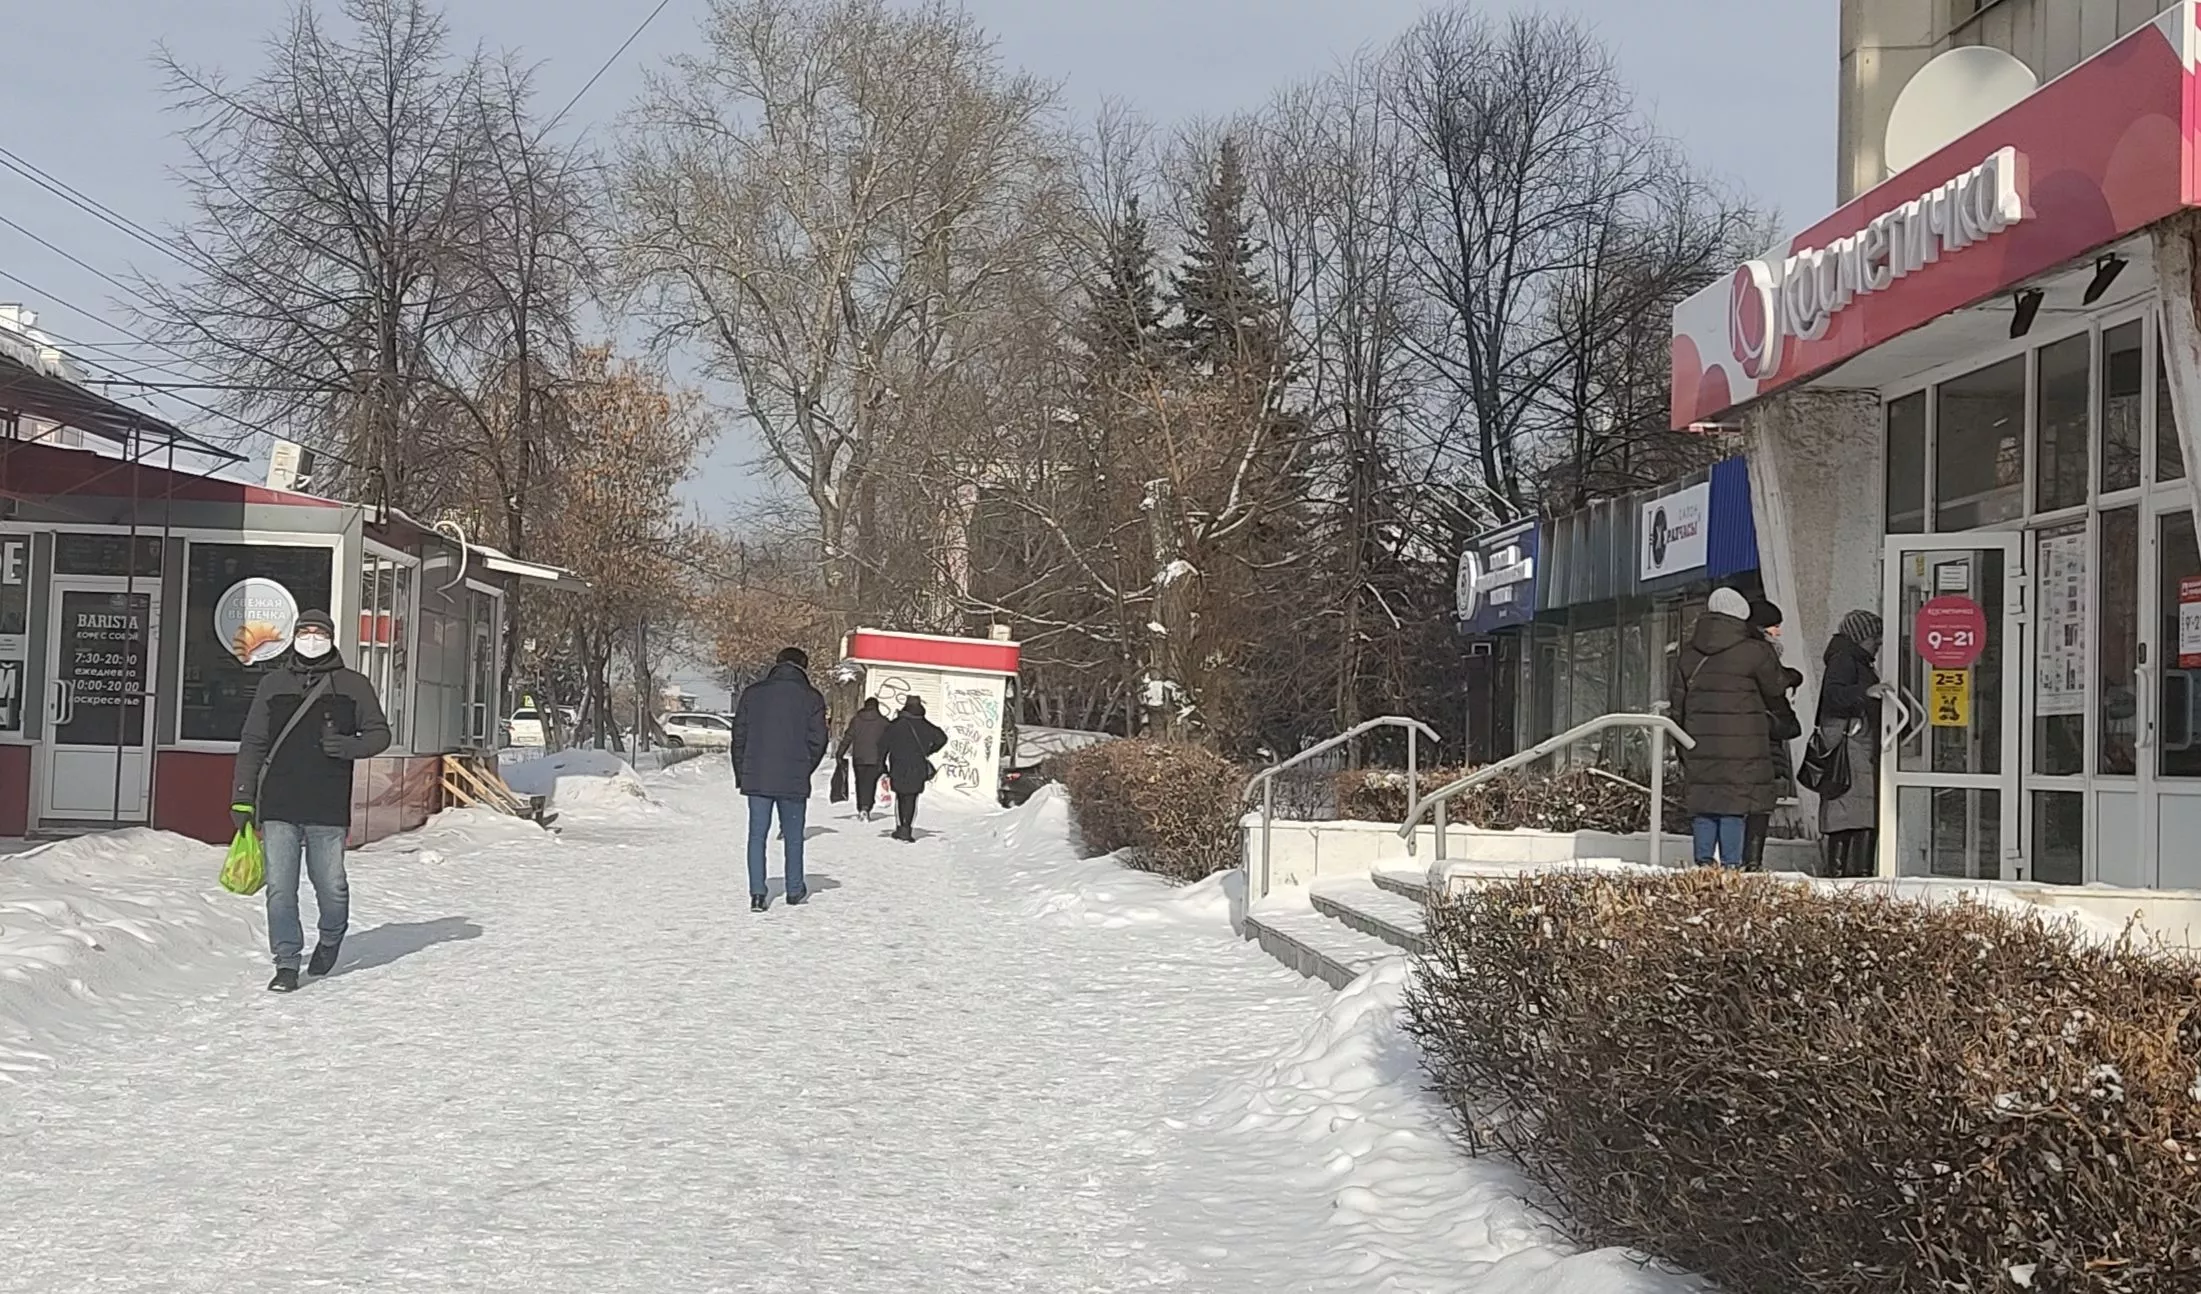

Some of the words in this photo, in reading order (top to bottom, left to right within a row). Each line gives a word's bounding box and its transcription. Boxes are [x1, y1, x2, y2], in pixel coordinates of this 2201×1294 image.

[232, 598, 283, 608] СВЕЖАЯ
[228, 609, 287, 621] ВЫПЕЧКА
[77, 614, 139, 629] BARISTA
[1935, 673, 1964, 686] 2=3
[73, 680, 140, 692] 10:00-2000
[73, 696, 140, 706] оскресеье
